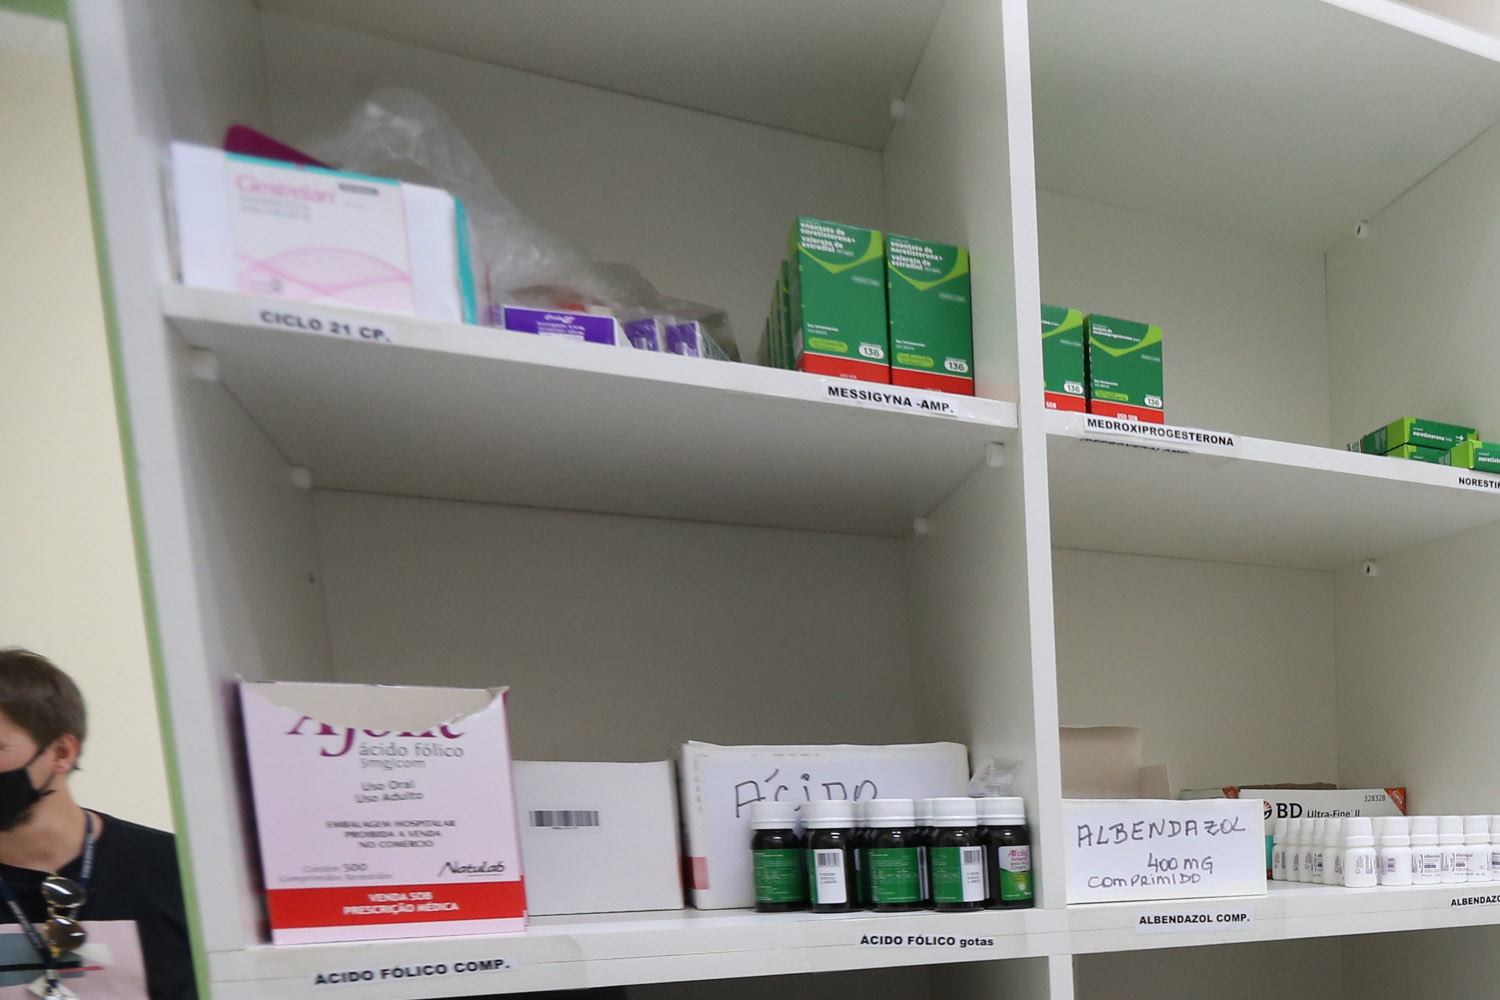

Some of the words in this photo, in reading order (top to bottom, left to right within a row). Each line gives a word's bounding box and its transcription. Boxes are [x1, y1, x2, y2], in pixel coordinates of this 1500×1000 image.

[259, 308, 322, 333] CICLO
[330, 321, 353, 337] 21
[359, 325, 392, 343] CP.
[828, 386, 912, 407] MESSIGYNA
[917, 400, 954, 413] -AMP.
[1086, 417, 1235, 447] MEDROXIPROGESTERONA
[358, 743, 409, 757] ácido
[415, 743, 464, 757] fólico
[1364, 794, 1386, 803] 328328
[1276, 803, 1303, 819] BD
[1077, 816, 1246, 848] ALBENDAZOL
[368, 893, 409, 902] VENDA
[410, 892, 433, 900] SOB
[342, 903, 415, 915] PRESCRIÇÃO
[417, 902, 459, 912] MÉDICA
[1139, 913, 1213, 925] ALBENDAZOL
[1216, 912, 1250, 923] COMP.
[860, 935, 903, 946] ÁCIDO
[907, 935, 956, 946] FÓLICO
[959, 937, 994, 948] gotas
[454, 959, 510, 973] COMP.
